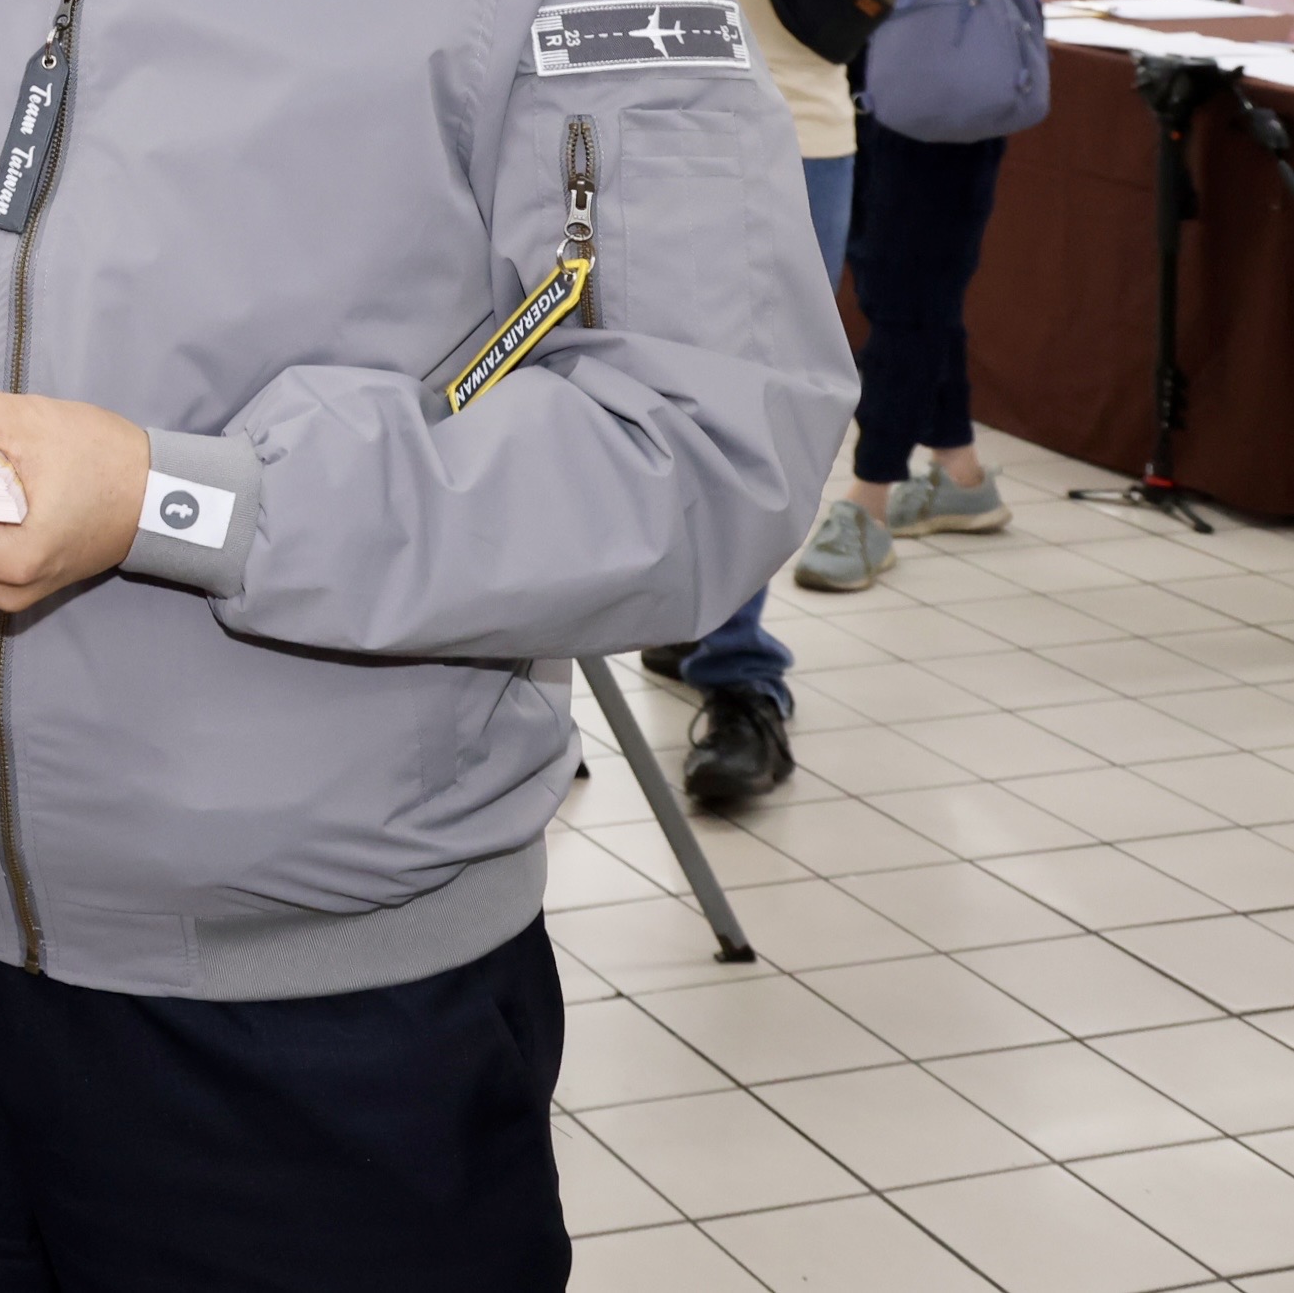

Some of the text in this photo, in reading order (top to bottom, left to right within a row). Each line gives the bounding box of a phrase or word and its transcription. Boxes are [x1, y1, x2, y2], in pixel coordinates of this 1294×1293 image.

[544, 29, 582, 48] 23 R
[20, 82, 53, 136] Team
[455, 281, 566, 407] TIGERAIR TAIWAN
